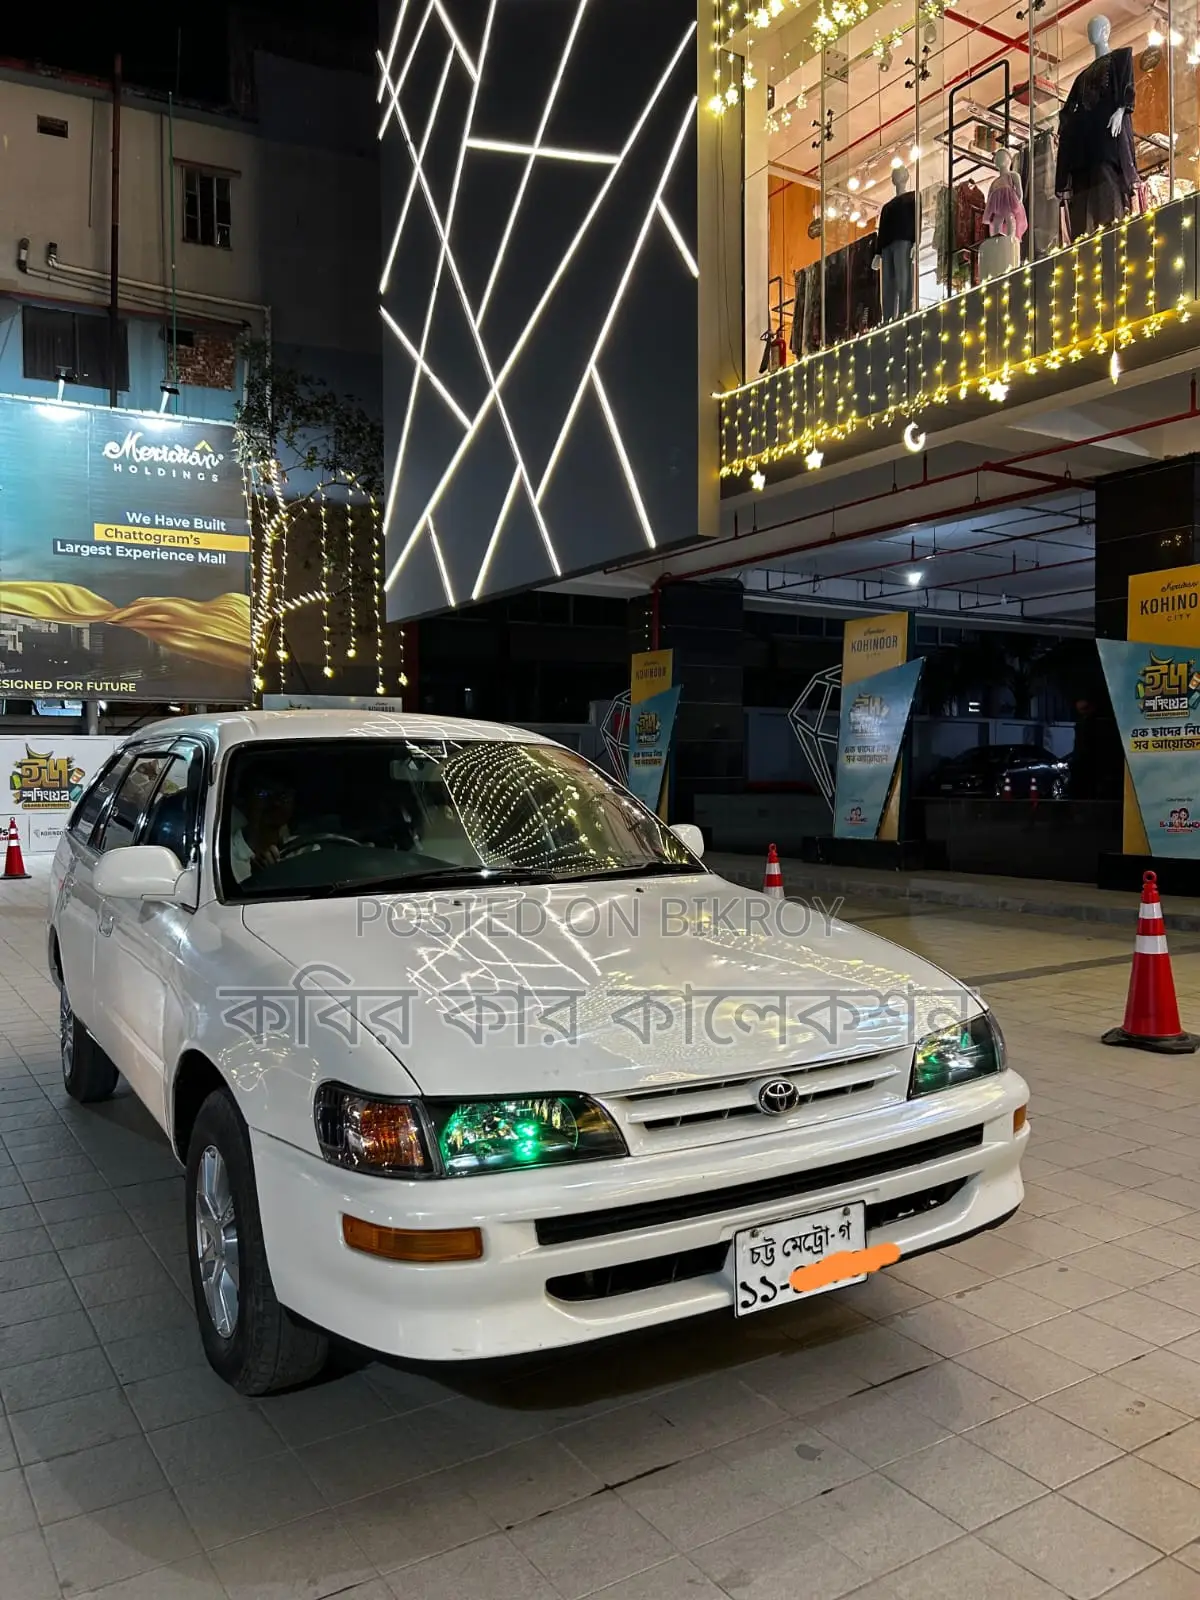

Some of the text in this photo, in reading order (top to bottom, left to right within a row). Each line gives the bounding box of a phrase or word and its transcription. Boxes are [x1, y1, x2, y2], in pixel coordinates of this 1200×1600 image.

[102, 430, 219, 469] Meridian
[113, 463, 219, 482] HOLDINGS
[126, 511, 226, 531] We Have Built
[104, 528, 200, 545] Chattogram's
[57, 540, 226, 565] Largest Experience Mall
[56, 680, 83, 691] FOR
[87, 681, 137, 692] FUTURE
[1131, 729, 1149, 738] এক
[1134, 740, 1150, 750] সব
